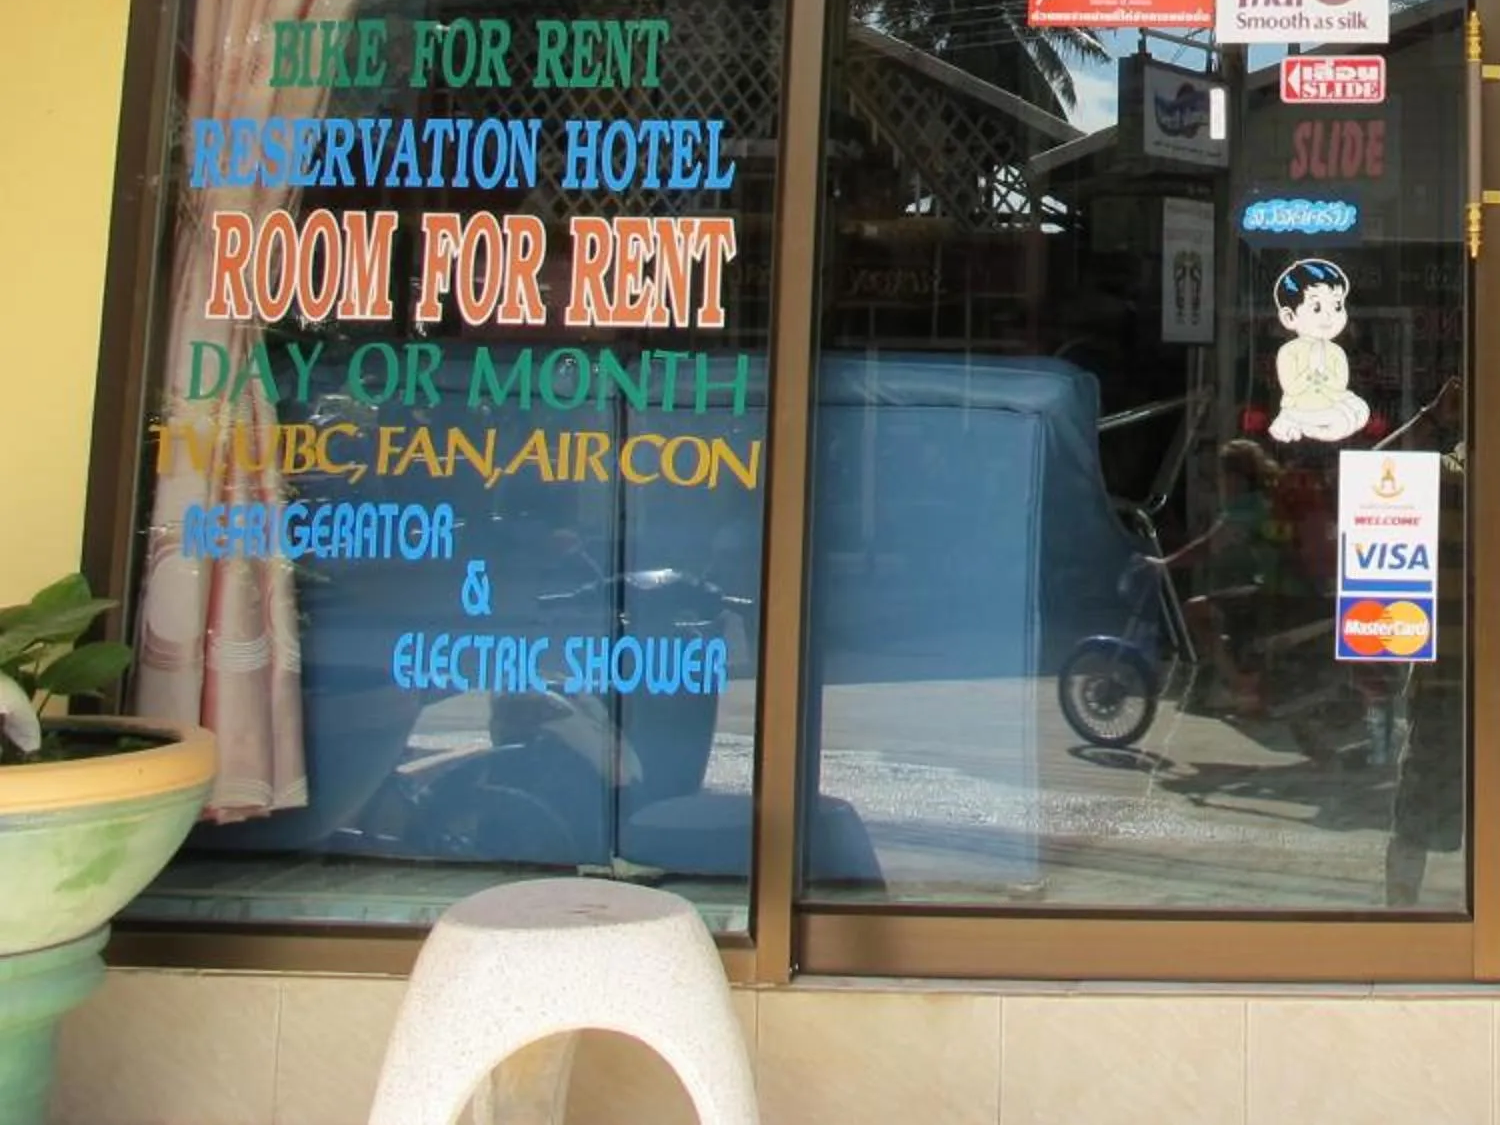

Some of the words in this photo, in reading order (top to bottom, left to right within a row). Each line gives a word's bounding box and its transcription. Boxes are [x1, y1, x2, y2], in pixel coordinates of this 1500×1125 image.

[1236, 11, 1310, 30] Smooth
[1313, 16, 1335, 30] as
[1337, 11, 1368, 30] silk
[269, 18, 389, 89] BIKE
[410, 16, 511, 88] FOR
[534, 18, 669, 89] RENT
[1303, 81, 1379, 100] SLIDE
[190, 119, 542, 189] RESERVATION
[562, 119, 735, 190] HOTEL
[1289, 120, 1387, 181] SLIDE
[206, 208, 400, 323] ROOM
[415, 210, 548, 326] FOR
[565, 216, 736, 329] RENT
[187, 339, 326, 407] DAY
[349, 342, 442, 407] OR
[468, 346, 750, 417] MONTH
[181, 502, 453, 560] REFRIGERATOR
[1354, 516, 1422, 526] WELCOME
[1355, 543, 1430, 570] VISA
[461, 559, 490, 617] &
[1344, 619, 1429, 636] MasterCard
[393, 632, 548, 691] ELECTRIC
[565, 636, 728, 695] SHOWER
